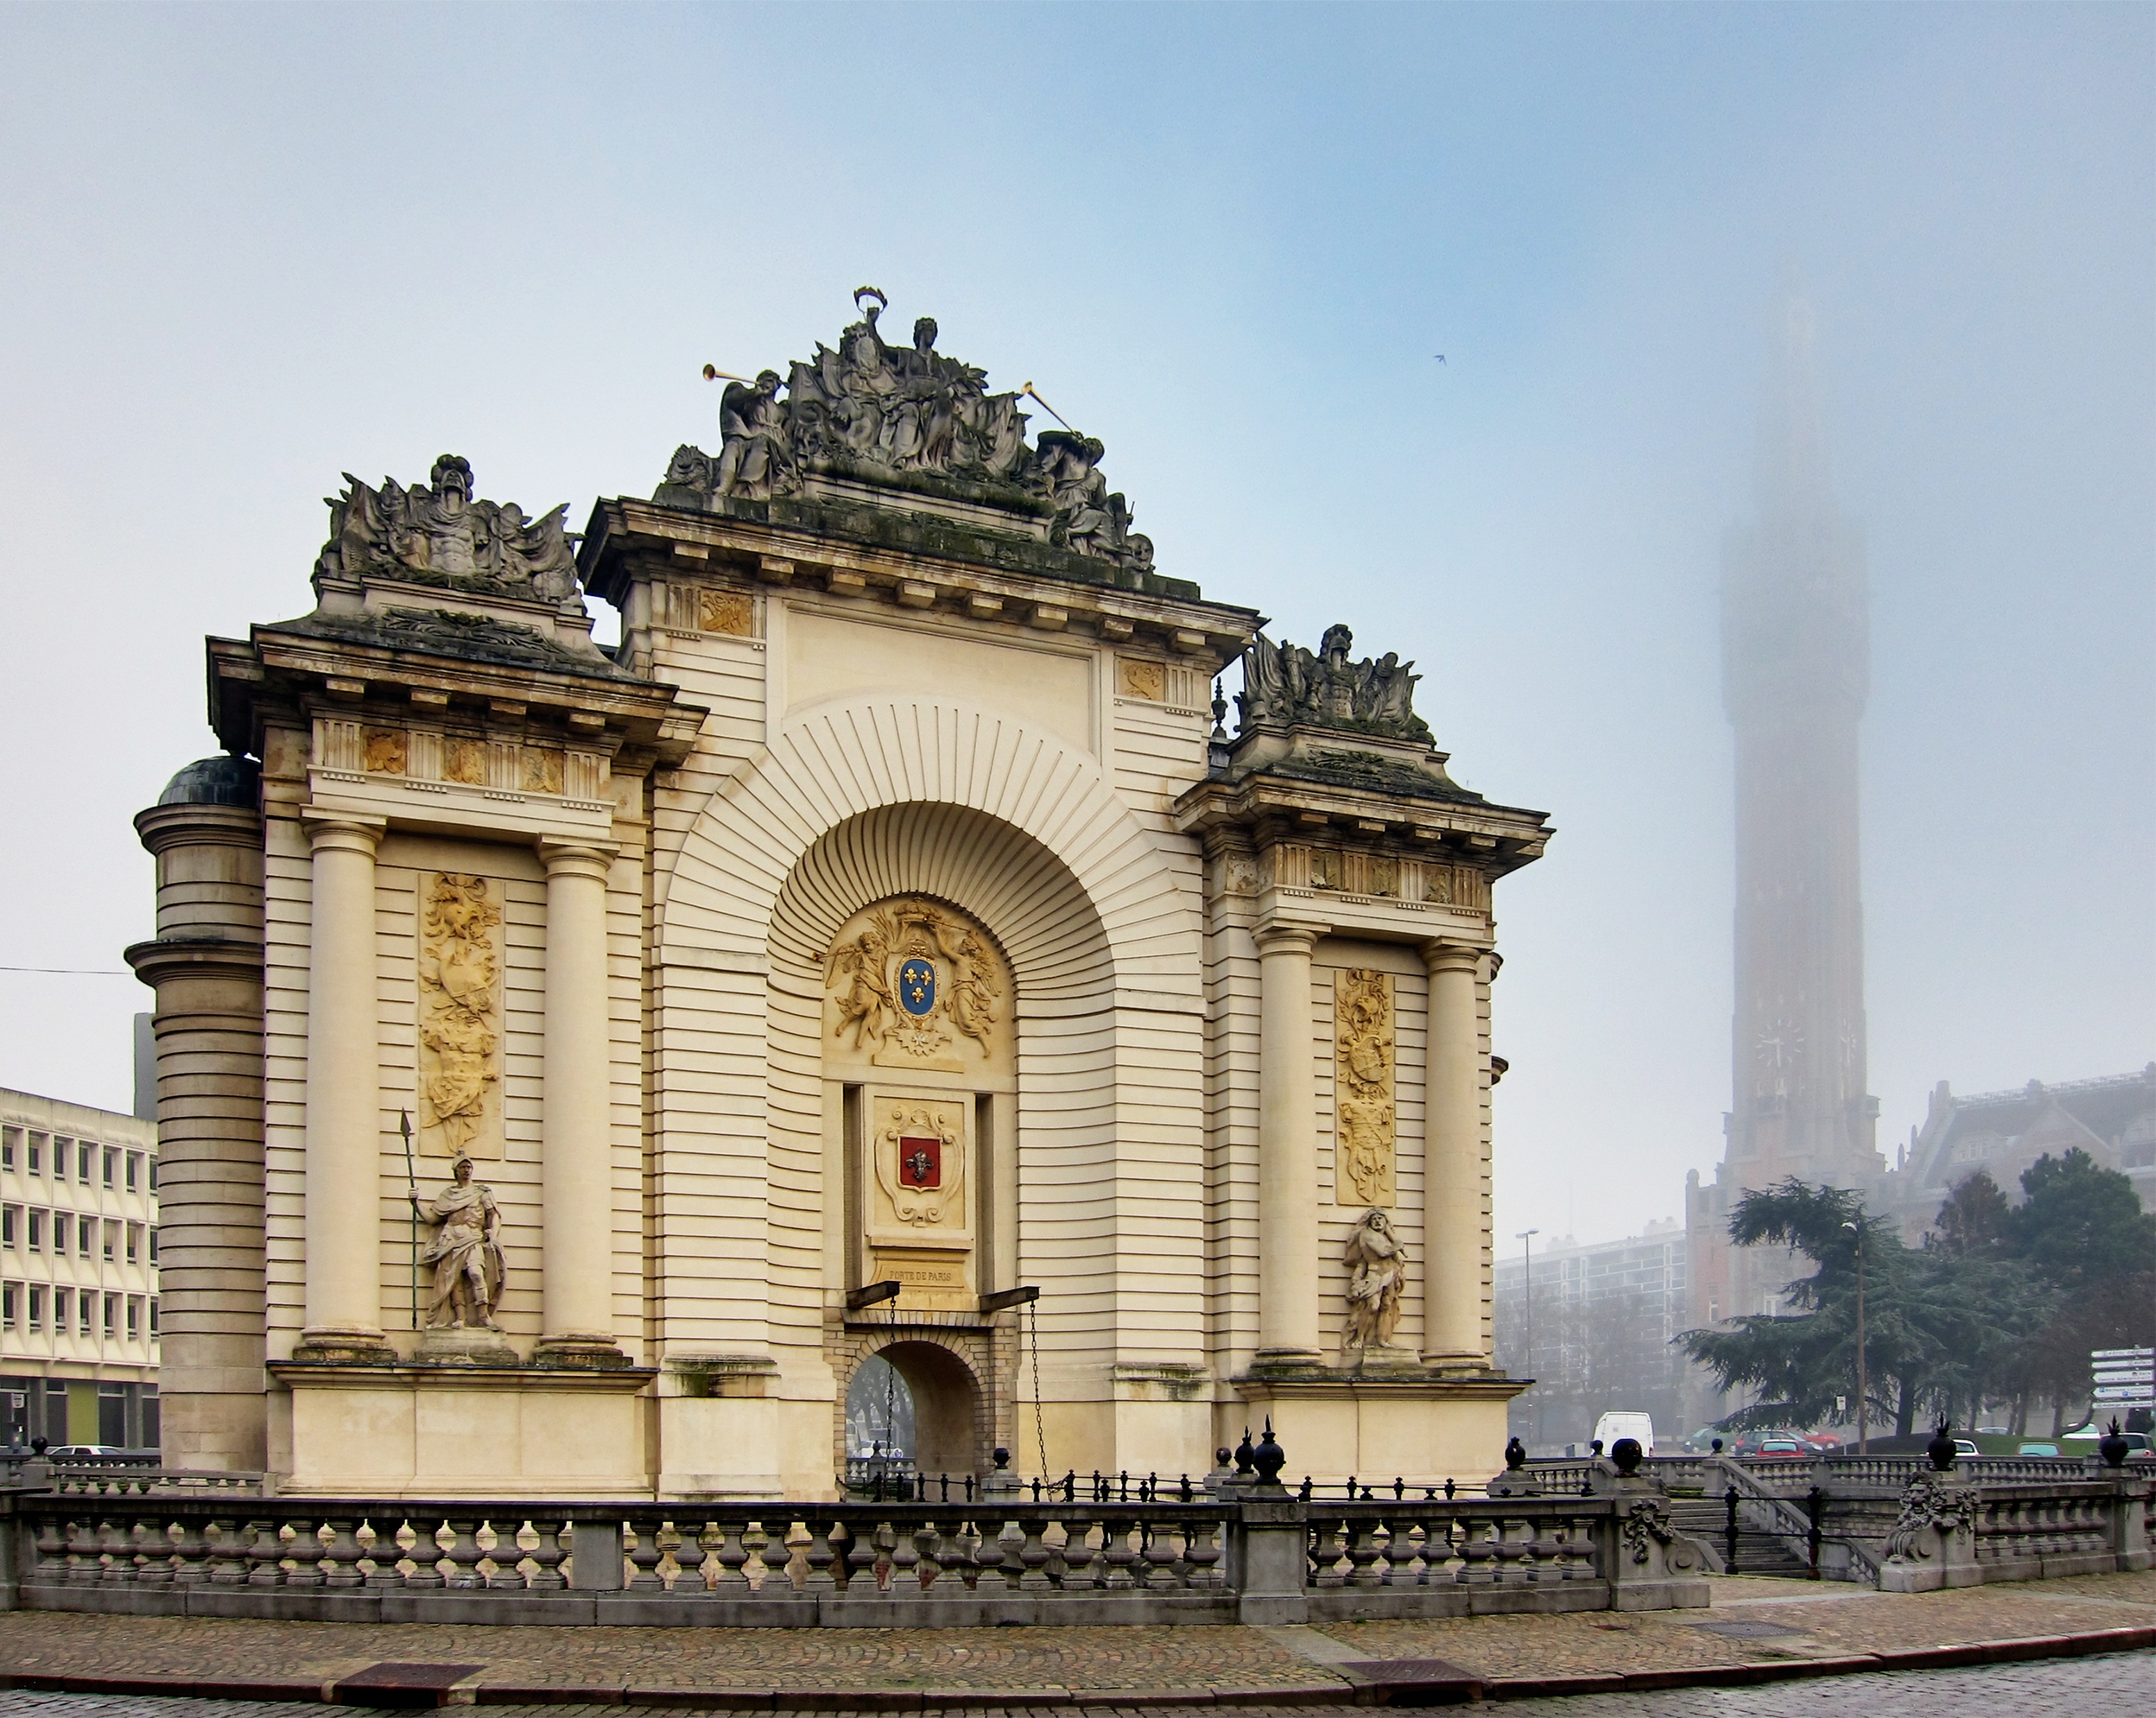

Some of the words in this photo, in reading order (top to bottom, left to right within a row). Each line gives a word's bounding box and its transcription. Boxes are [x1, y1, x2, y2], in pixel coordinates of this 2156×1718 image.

[890, 1271, 915, 1280] PORTE
[916, 1271, 927, 1281] DE
[928, 1271, 952, 1282] PARIS
